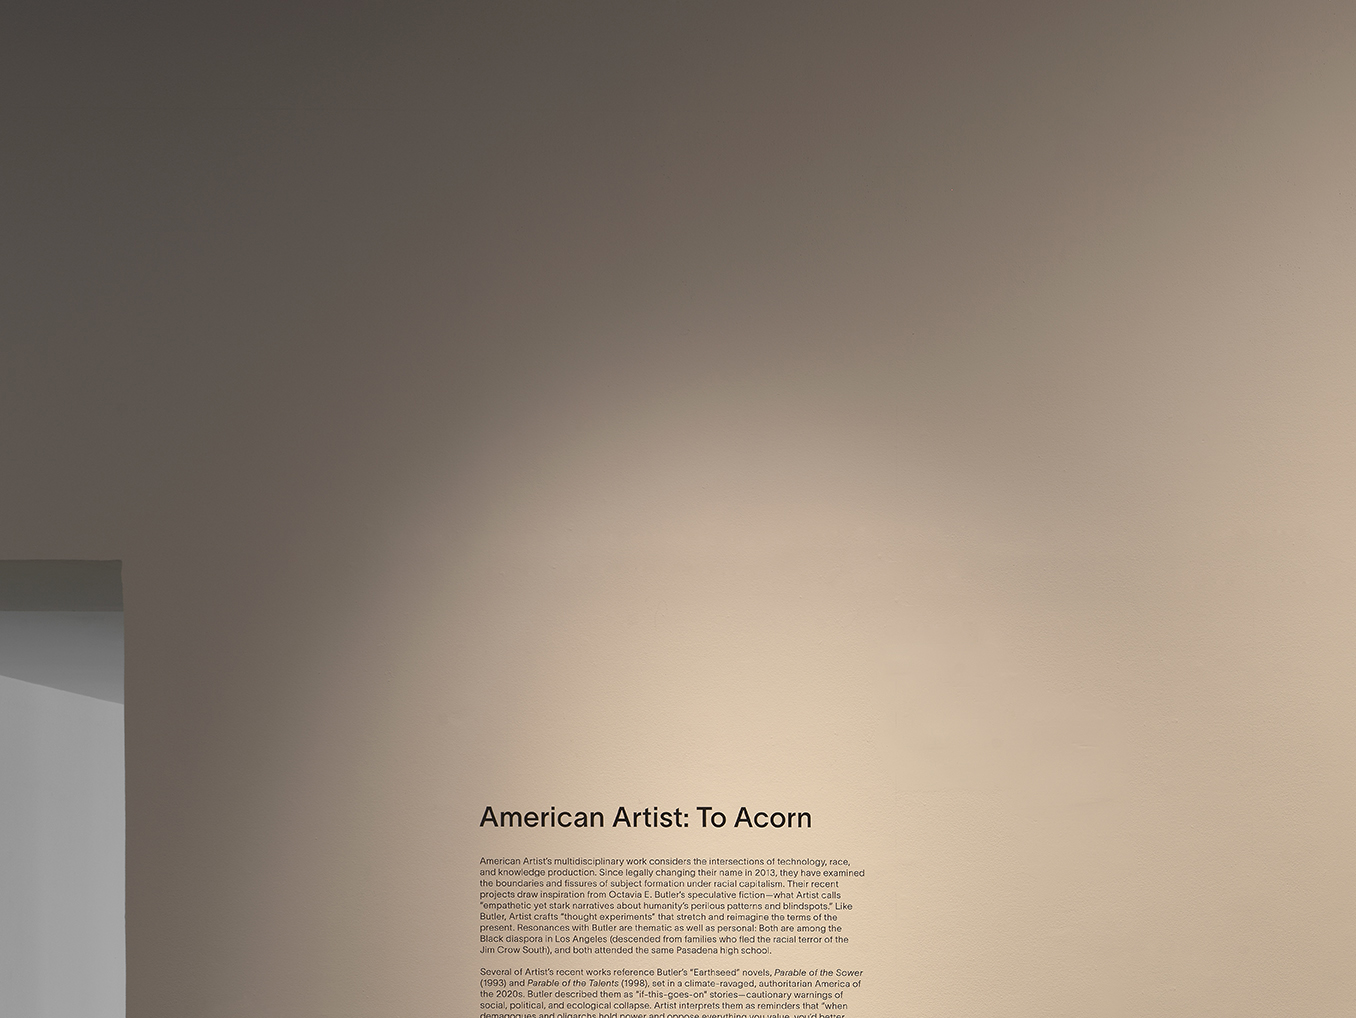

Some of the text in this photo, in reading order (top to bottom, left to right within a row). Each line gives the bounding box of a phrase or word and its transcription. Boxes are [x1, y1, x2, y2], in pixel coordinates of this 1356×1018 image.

[480, 806, 811, 827] American Artist: To Acorn
[480, 857, 520, 865] American
[554, 857, 624, 867] multidisciplinary
[626, 857, 647, 865] work
[649, 857, 691, 865] considers
[694, 857, 707, 865] the
[709, 857, 764, 865] intersections
[767, 857, 775, 866] of
[778, 857, 827, 868] technology,
[830, 859, 850, 867] race,
[480, 868, 496, 876] and
[498, 868, 545, 878] knowledge
[548, 868, 596, 878] production.
[599, 868, 623, 876] Since
[626, 868, 653, 878] legally
[656, 868, 695, 878] changing
[698, 868, 717, 876] their
[745, 868, 752, 876] in
[755, 868, 777, 878] 2013,
[780, 868, 798, 879] they
[801, 868, 821, 877] have
[823, 868, 864, 877] examined
[480, 879, 838, 890] the boundaries and fissures of subject formation under racial capitalism. Their recent
[480, 945, 495, 954] Jim
[497, 945, 520, 954] Crow
[523, 945, 552, 956] South),
[555, 945, 570, 954] and
[573, 945, 592, 954] both
[595, 946, 633, 954] attended
[636, 946, 649, 954] the
[677, 946, 718, 954] Pasadena
[720, 946, 739, 956] high
[741, 946, 771, 954] school.
[480, 978, 506, 989] (1993)
[509, 978, 525, 987] and
[527, 978, 559, 987] Parable
[562, 978, 571, 987] of
[573, 978, 586, 987] the
[589, 978, 619, 987] Talents
[621, 979, 649, 989] (1998),
[652, 979, 665, 987] set
[667, 979, 675, 987] in
[685, 979, 756, 989] climate-ravaged,
[759, 979, 812, 987] authoritarian
[815, 979, 850, 987] America
[853, 979, 861, 987] of
